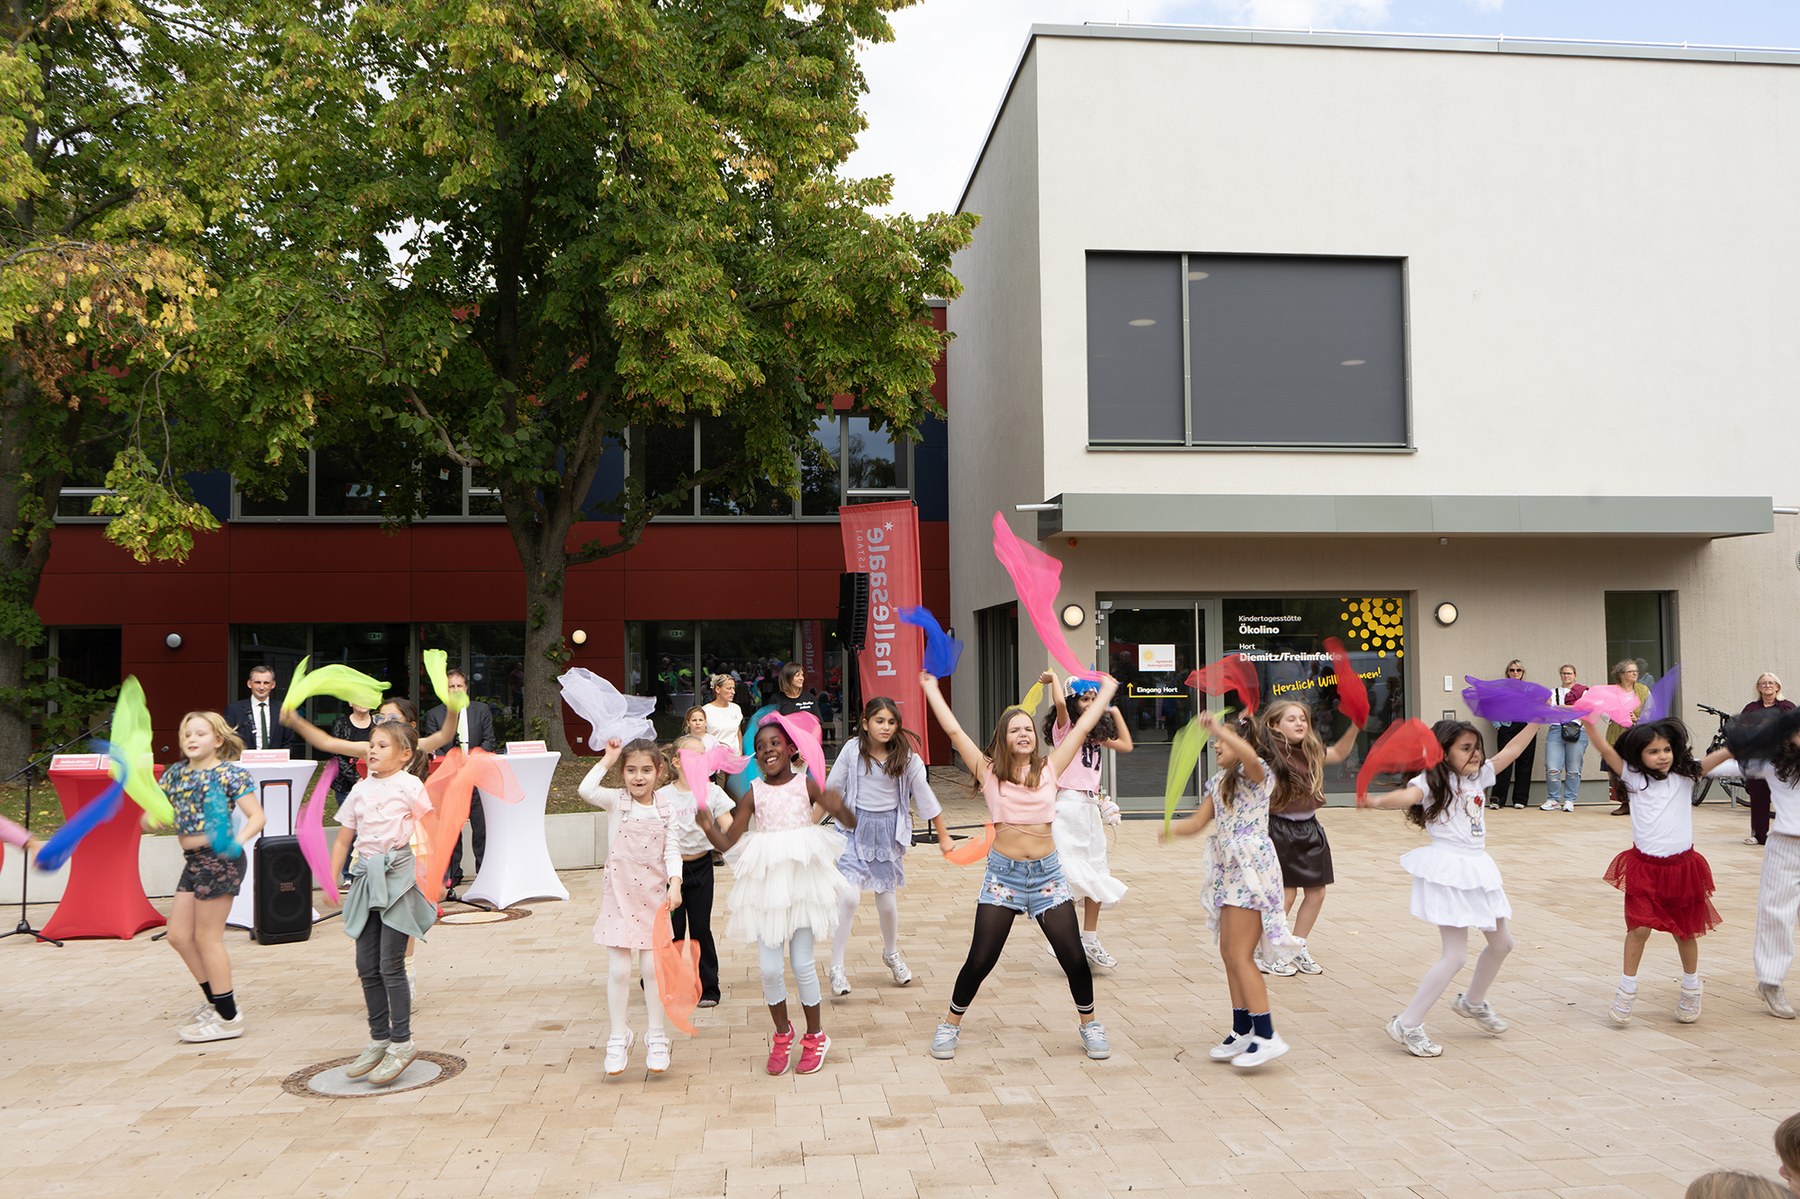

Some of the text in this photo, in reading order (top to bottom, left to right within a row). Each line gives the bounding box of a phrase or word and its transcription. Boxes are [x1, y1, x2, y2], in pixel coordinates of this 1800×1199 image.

[1239, 615, 1302, 623] Kindertagesstätte
[1239, 624, 1280, 634] Ökolino
[1272, 666, 1382, 696] Herzlich Willmen!
